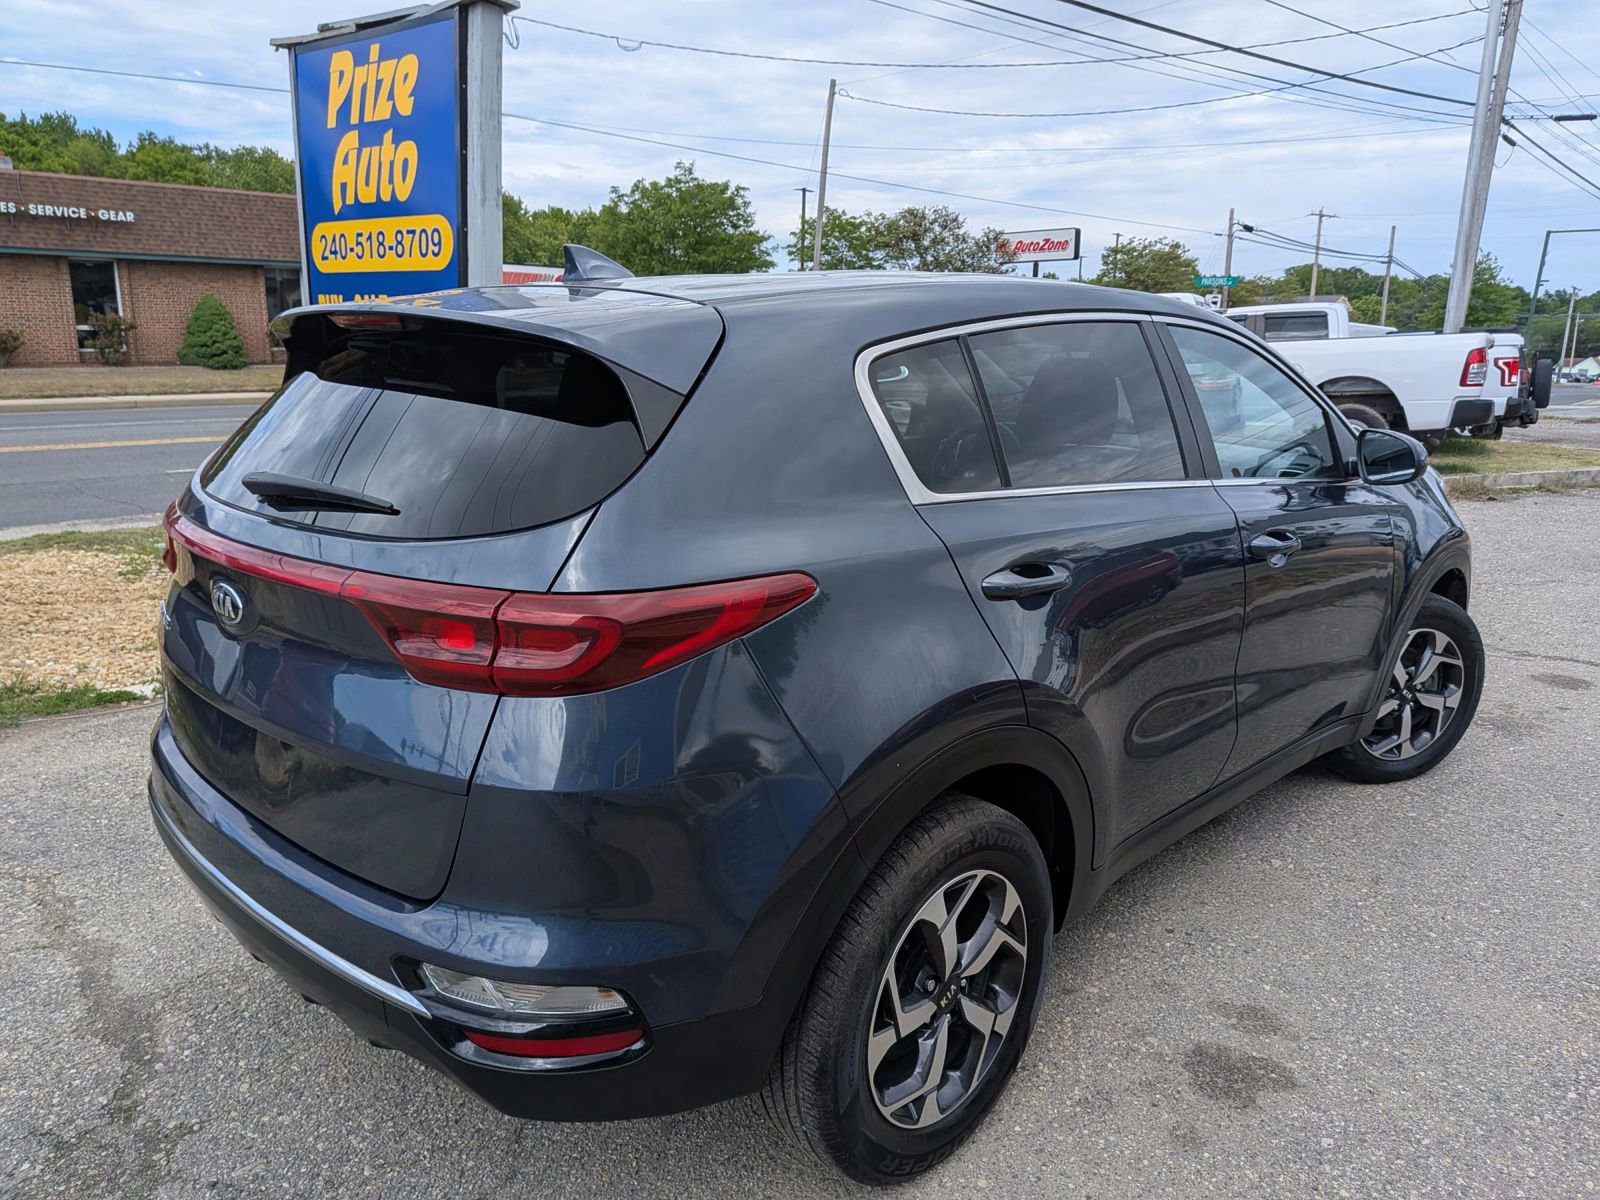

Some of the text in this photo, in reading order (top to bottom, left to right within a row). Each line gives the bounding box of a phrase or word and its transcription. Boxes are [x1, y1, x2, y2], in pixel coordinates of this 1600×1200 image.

[327, 43, 419, 128] Prize
[332, 128, 418, 216] Auto
[28, 203, 87, 219] SERVICE
[98, 209, 135, 222] GEAR
[319, 227, 442, 262] 240-518-8709
[1013, 238, 1069, 253] AutoZone
[1201, 277, 1227, 286] PARSONS
[940, 984, 957, 1008] KIA
